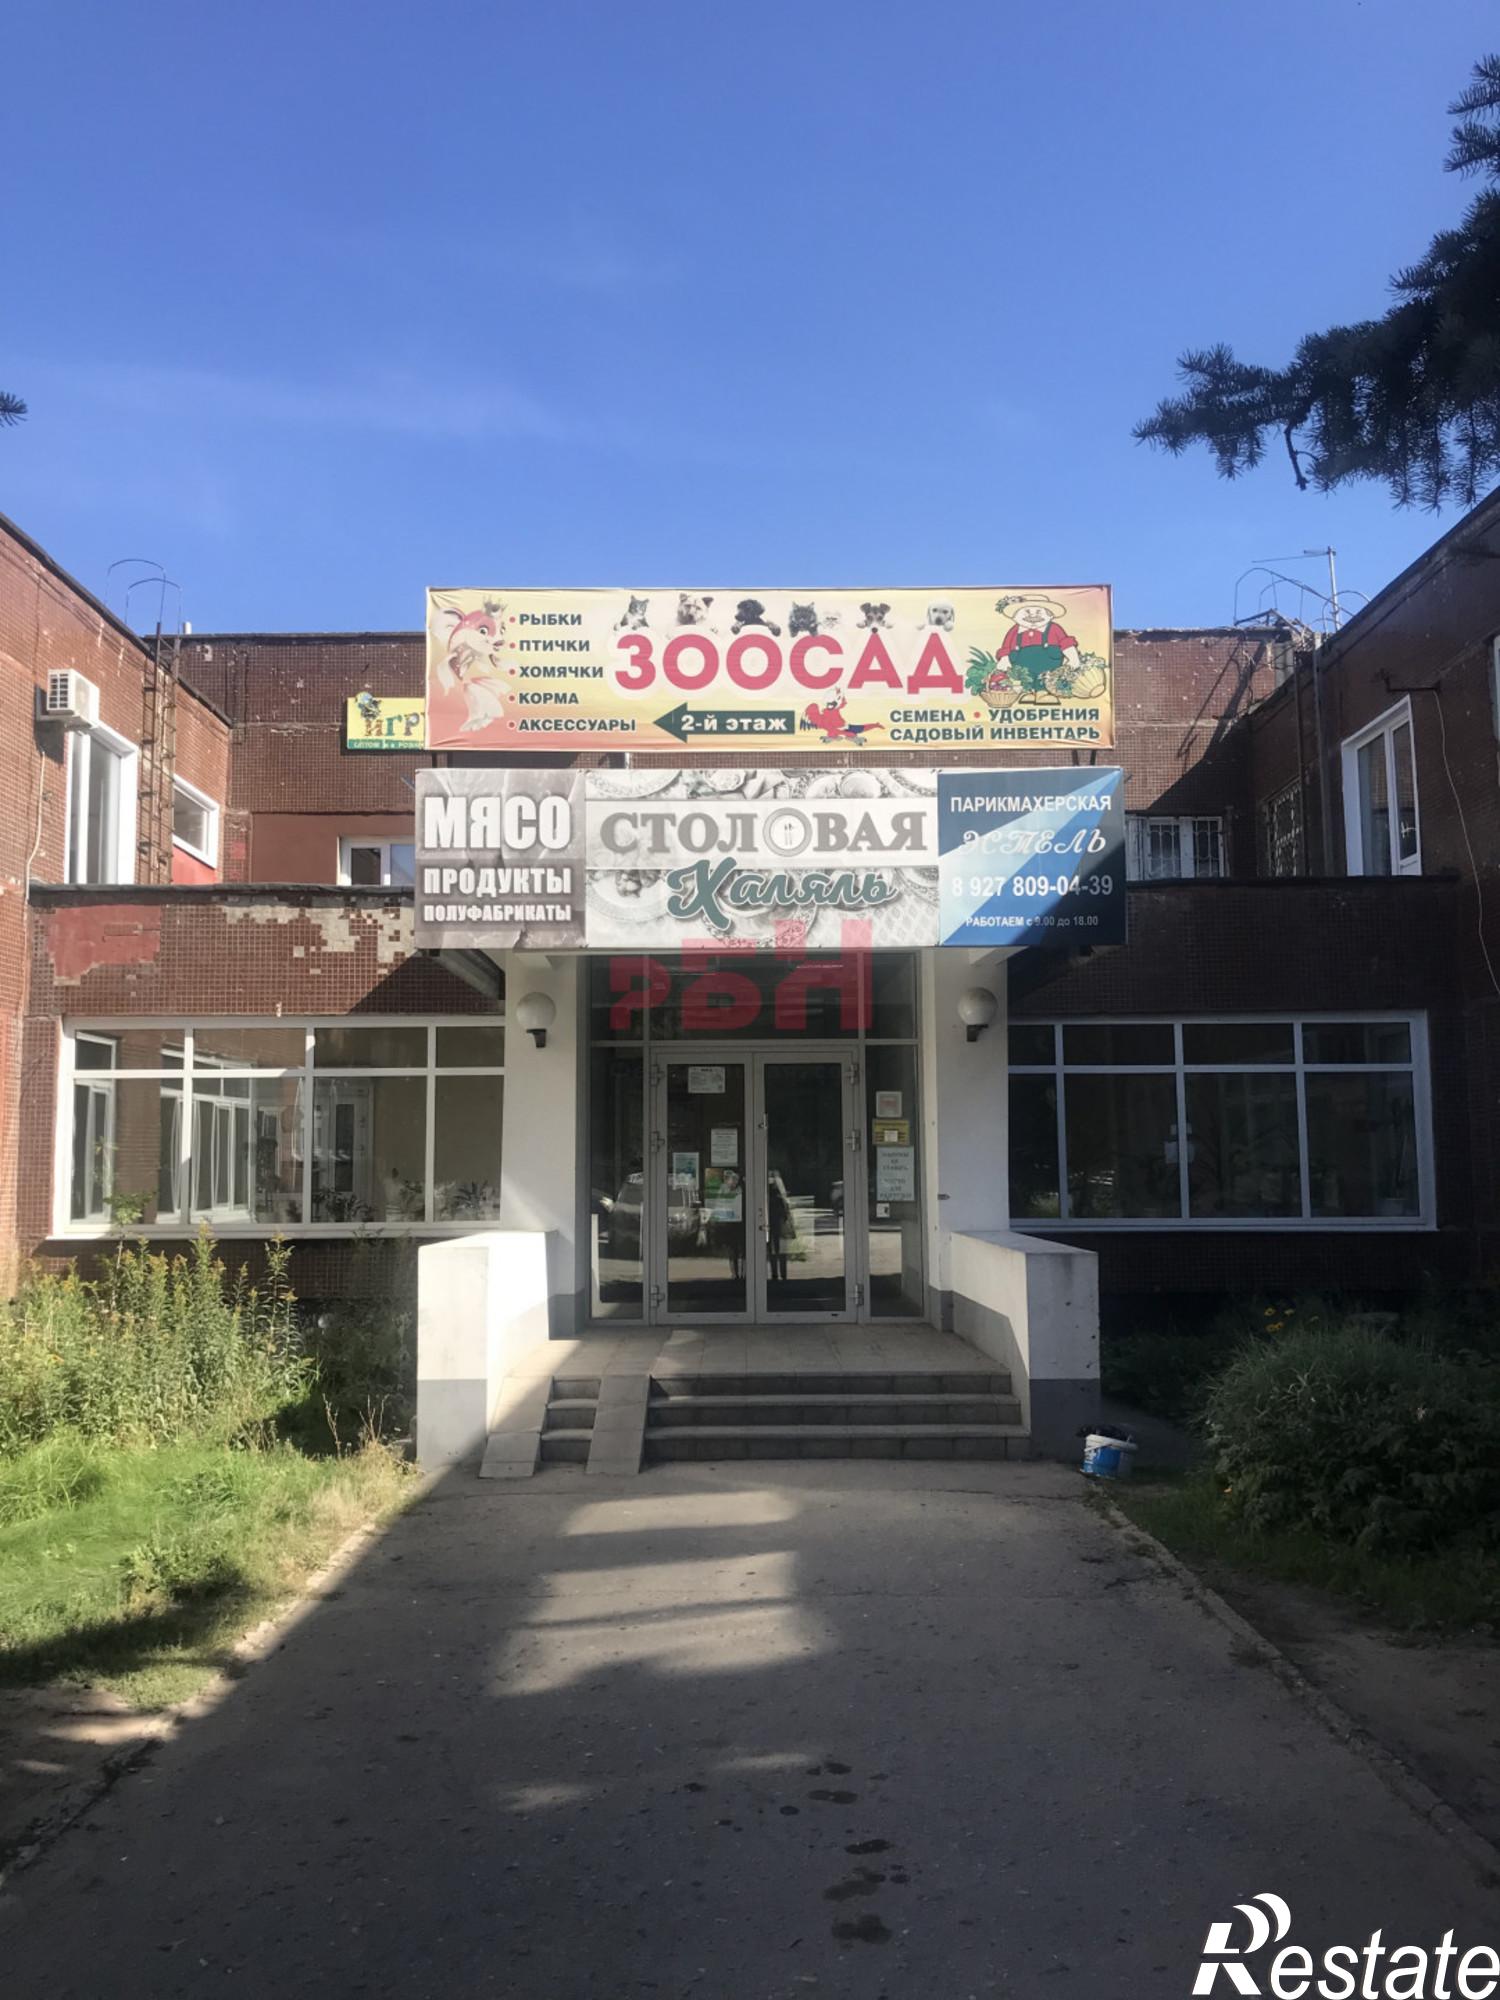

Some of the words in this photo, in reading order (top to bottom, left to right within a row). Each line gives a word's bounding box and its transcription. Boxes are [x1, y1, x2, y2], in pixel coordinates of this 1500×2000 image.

[519, 613, 582, 626] РЫБКИ
[519, 639, 590, 652] ПТИЧКИ
[519, 666, 604, 678] ХОМЯЧКИ
[615, 633, 964, 694] ЗООСАД
[519, 692, 579, 705] КОРМА
[364, 712, 426, 737] ИГР
[519, 718, 636, 732] АКСЕССУАРЫ
[680, 713, 717, 731] 2-й
[725, 716, 788, 731] этаж
[889, 709, 965, 723] СЕМЕНА
[989, 708, 1100, 724] УДОБРЕНИЯ
[889, 725, 984, 743] САДОВЫЙ
[990, 726, 1101, 741] ИНВЕНТАРЬ
[950, 795, 1112, 813] ПАРИКМАХЕРСКАЯ
[424, 796, 571, 850] МЯСО
[599, 807, 928, 857] СТОЛОВАЯ
[424, 868, 572, 897] ПРОДУКТЫ
[951, 876, 962, 897] 8
[970, 876, 1003, 897] 927
[1012, 874, 1113, 898] 809-04-39
[666, 856, 899, 931] Халяль
[424, 905, 572, 922] ПОЛУФАБРИКАТЫ
[966, 916, 1024, 928] РАБОТАЕМ
[1026, 918, 1033, 927] с
[1034, 916, 1054, 927] 9.00
[1057, 917, 1070, 928] до
[1073, 915, 1098, 926] 18.00
